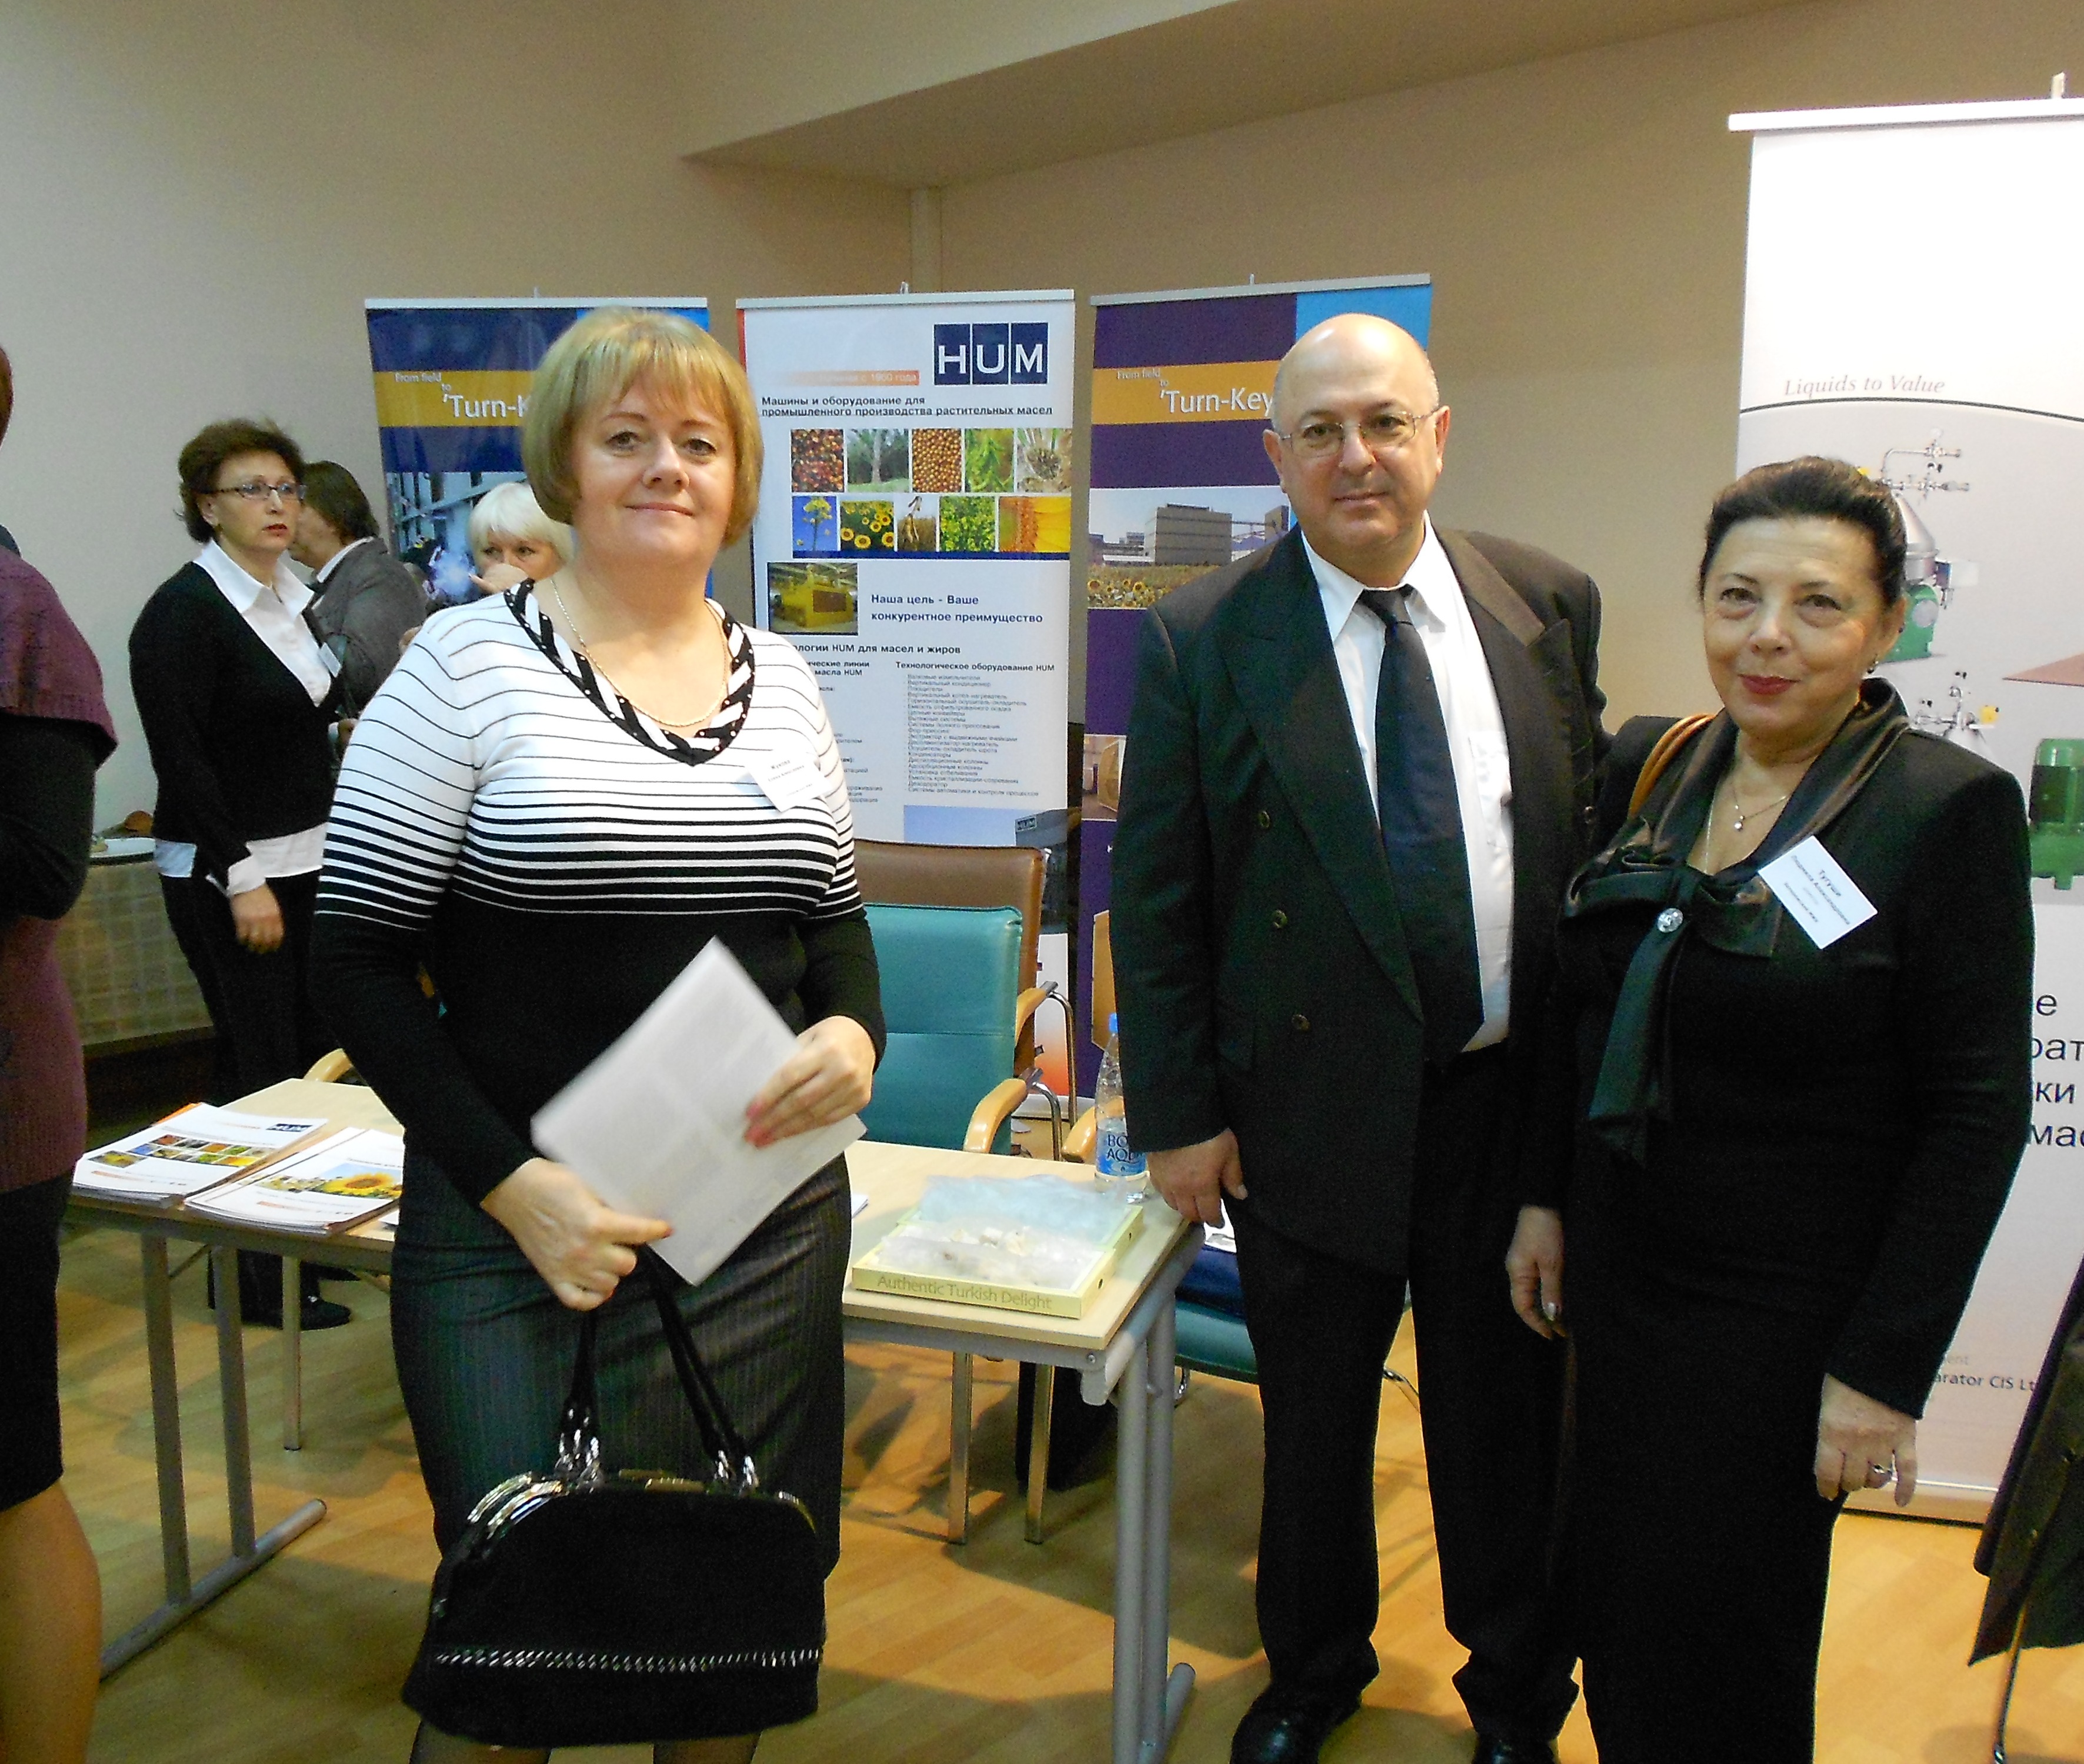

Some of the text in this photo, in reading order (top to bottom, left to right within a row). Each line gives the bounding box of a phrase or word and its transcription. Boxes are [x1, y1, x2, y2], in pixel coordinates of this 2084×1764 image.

[938, 343, 1043, 375] HUM
[395, 372, 419, 382] From
[1116, 368, 1161, 379] From field
[1785, 375, 1945, 399] Liquids to Value
[761, 396, 809, 406] Машины
[822, 395, 902, 406] оборудование
[905, 396, 925, 406] для
[761, 406, 1053, 417] промышленного производства растительных масел
[871, 594, 903, 604] Наша
[906, 595, 935, 605] цель
[946, 595, 979, 605] Ваше
[871, 612, 1043, 624] конкурентное преимущество
[832, 644, 855, 652] HUM
[858, 645, 878, 653] для
[926, 646, 961, 655] жиров
[895, 661, 969, 670] Технологическое
[971, 663, 1033, 672] оборудование
[877, 1276, 1052, 1310] Authentic Turkish Delight
[1989, 1375, 2015, 1389] CIS
[2019, 1379, 2036, 1391] Lt
